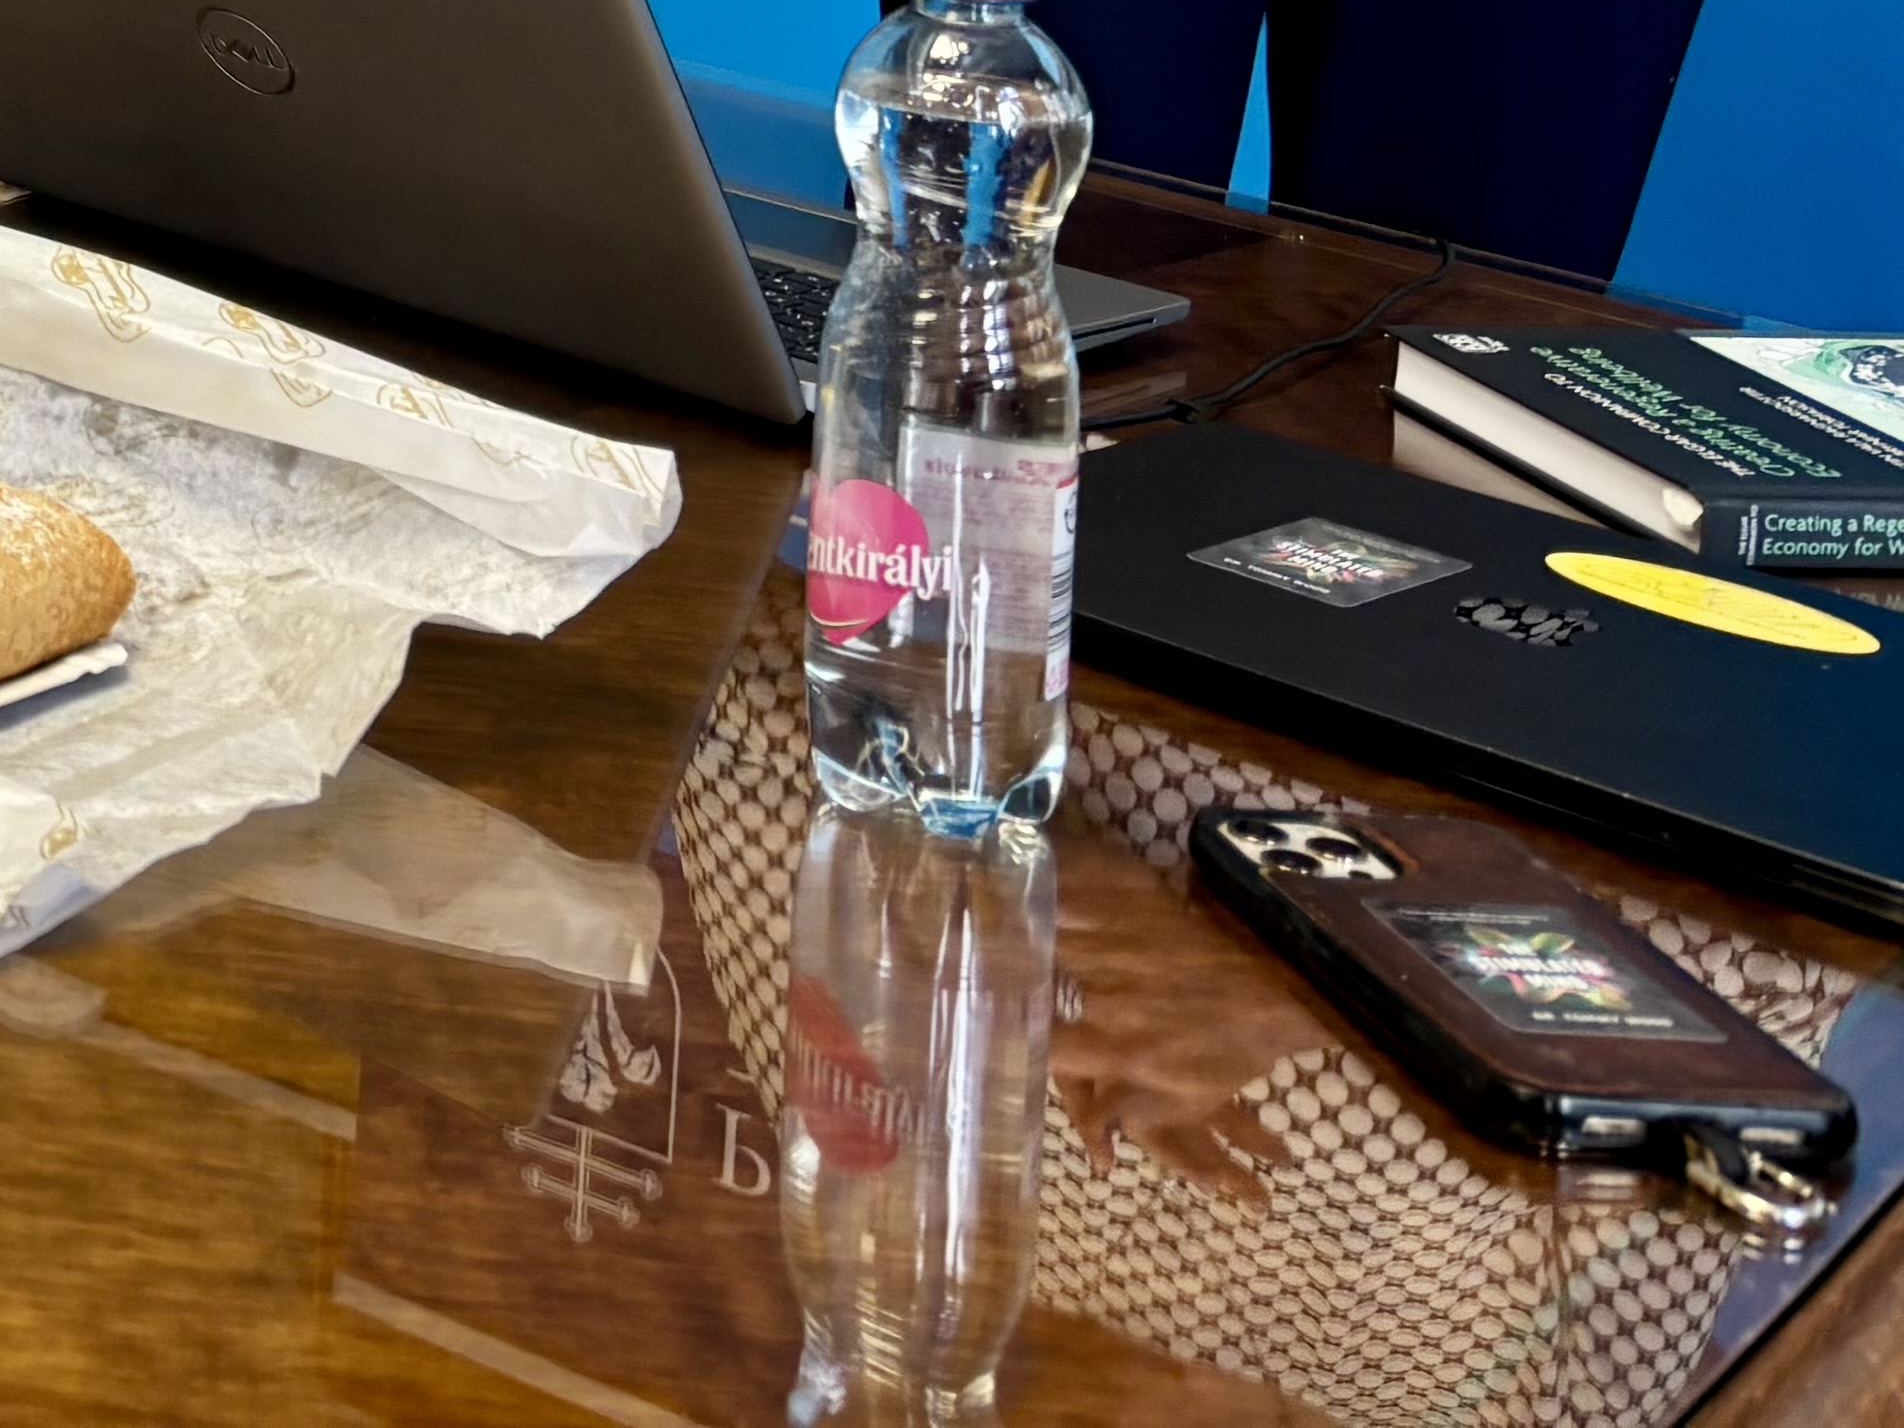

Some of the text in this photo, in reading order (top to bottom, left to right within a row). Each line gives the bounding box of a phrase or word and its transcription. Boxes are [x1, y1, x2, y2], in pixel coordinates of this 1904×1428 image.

[1764, 513, 1904, 537] Creating a Rege
[1762, 537, 1850, 559] Economy
[1854, 536, 1884, 555] for
